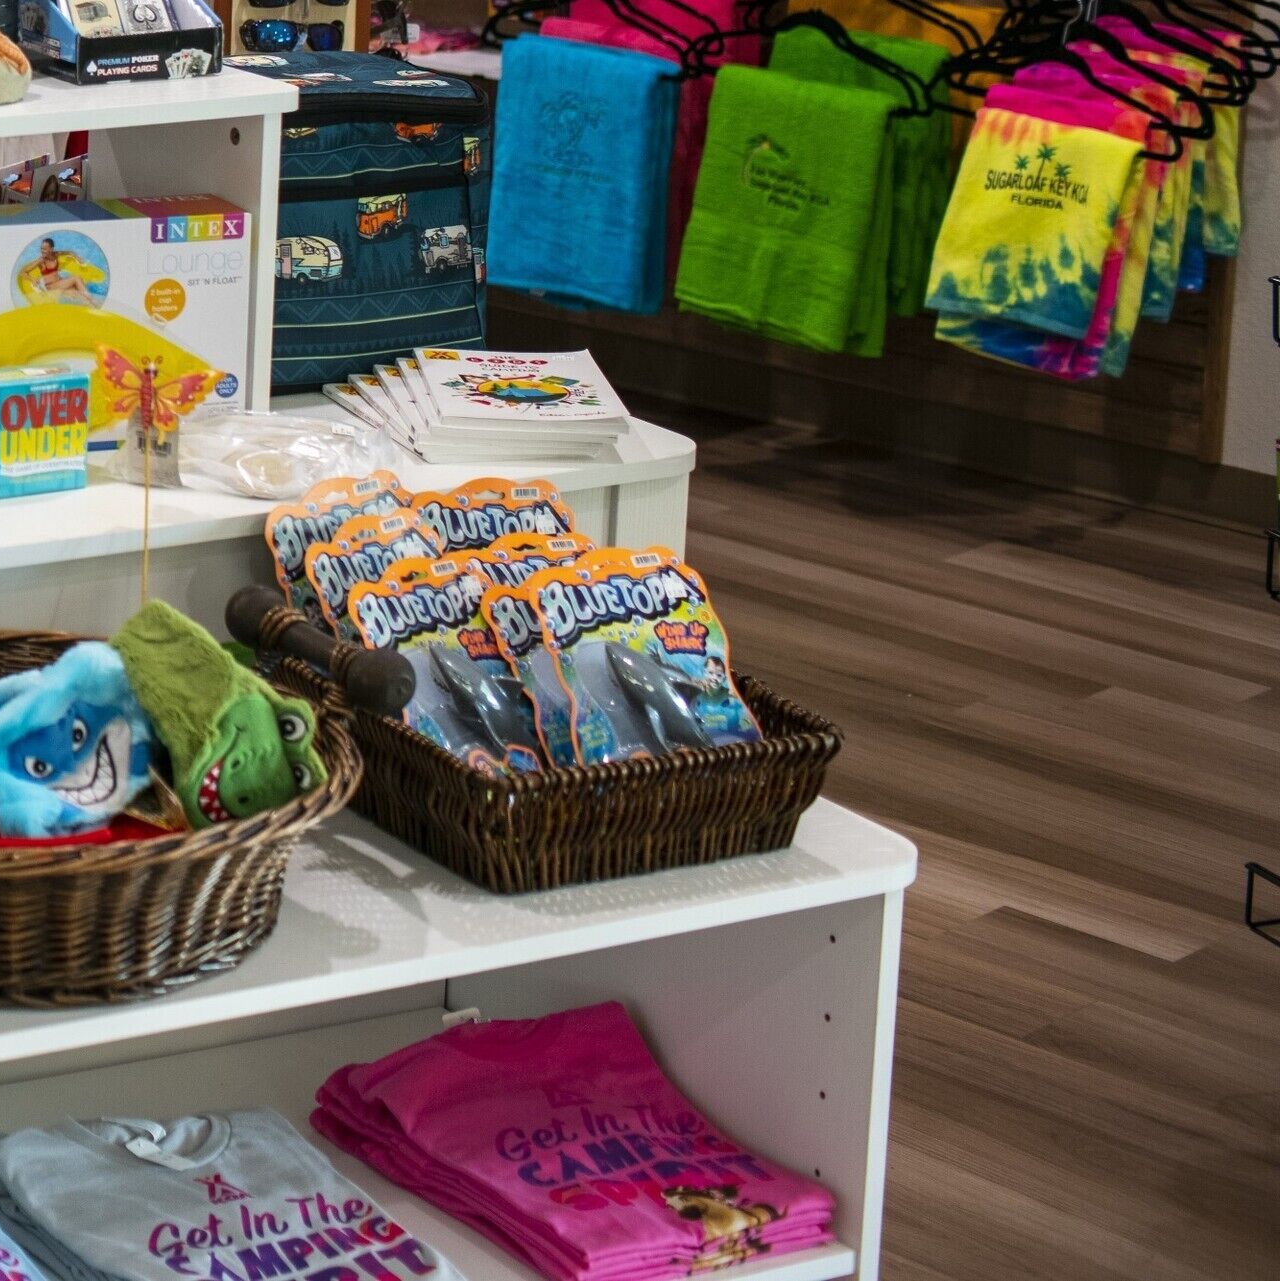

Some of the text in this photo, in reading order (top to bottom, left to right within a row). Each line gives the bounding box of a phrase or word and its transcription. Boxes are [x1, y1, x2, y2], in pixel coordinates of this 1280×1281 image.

[97, 54, 159, 67] PREMIUM POKER
[97, 64, 158, 77] PLAYING CARDS
[985, 169, 1071, 198] SUGARLOAF KEY
[1011, 194, 1063, 210] FLORIDA
[155, 218, 239, 240] INTEX
[1, 388, 89, 432] OVER
[495, 1102, 705, 1163] Get In The
[518, 1131, 741, 1187] CAMPING
[148, 1191, 377, 1259] Get In The
[166, 1215, 406, 1281] CAMPING
